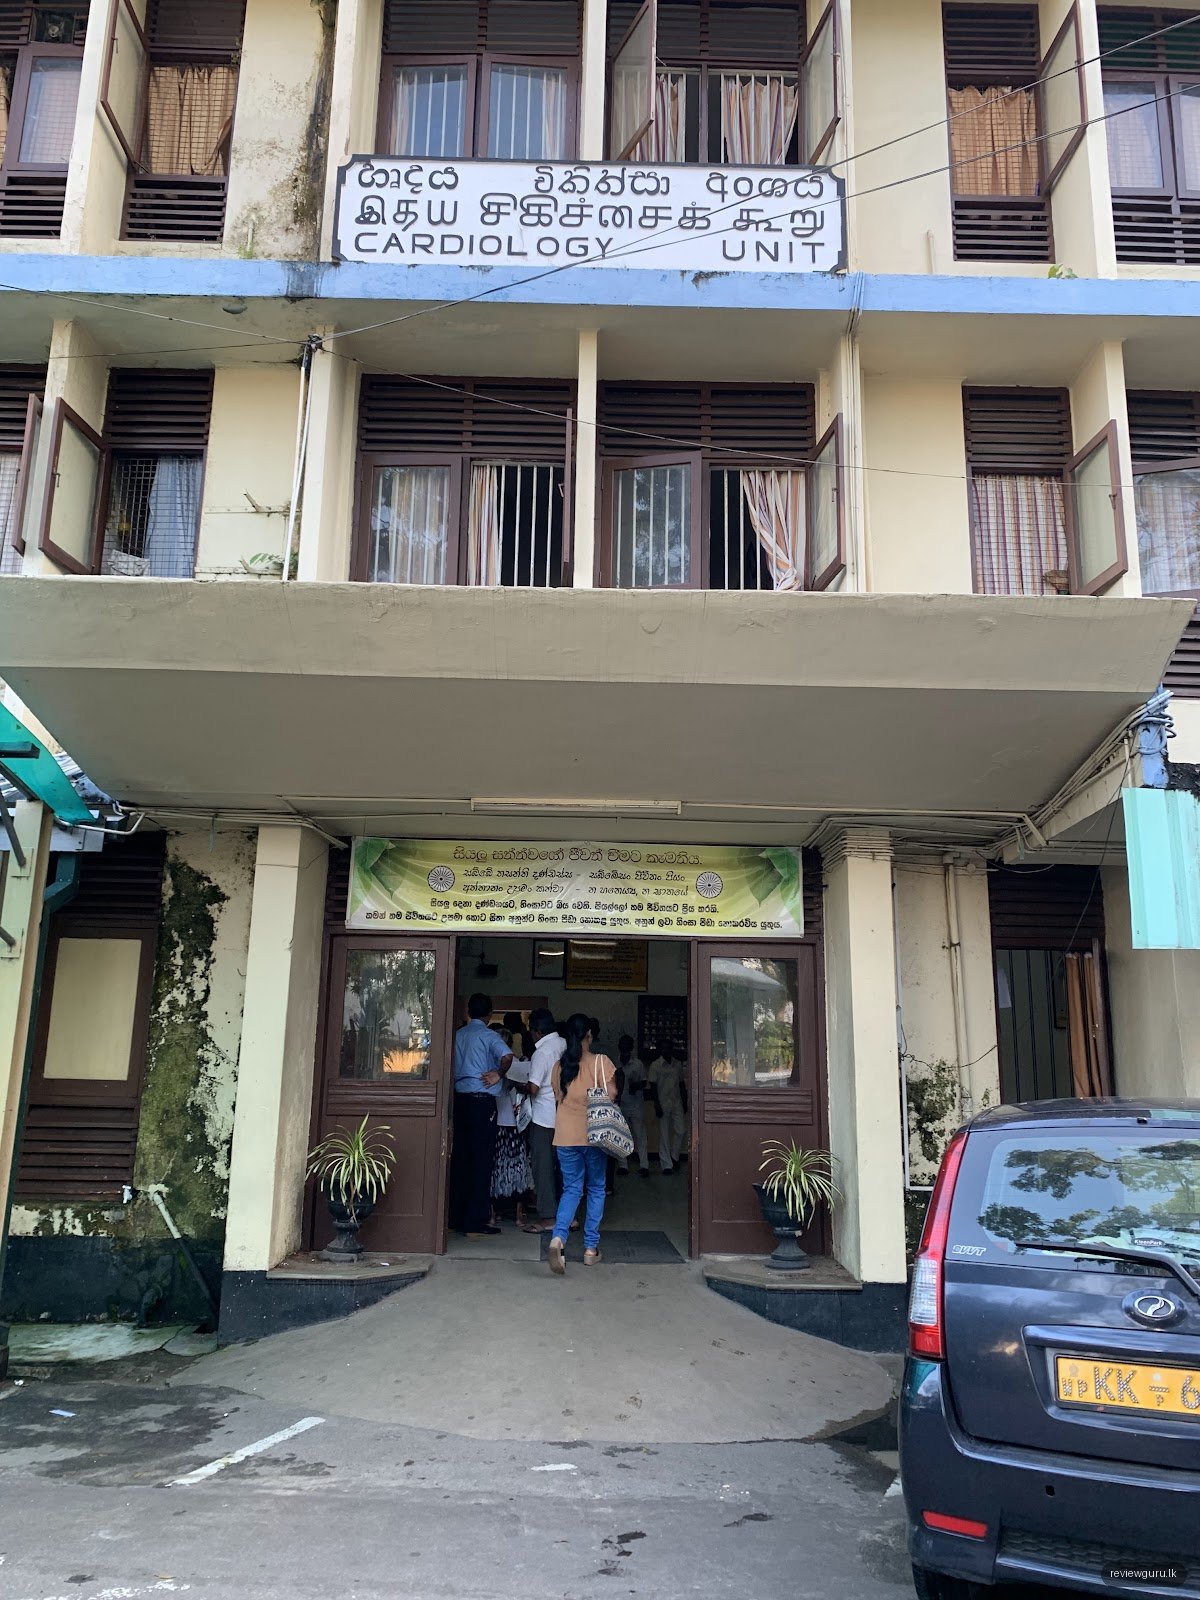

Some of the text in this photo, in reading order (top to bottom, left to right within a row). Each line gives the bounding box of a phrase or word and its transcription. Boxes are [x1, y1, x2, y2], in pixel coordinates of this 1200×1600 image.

[358, 162, 824, 203] හෘදය චිකිත්සා අංශය
[354, 192, 826, 239] இதய சிகிச்சைக் கூறு
[354, 232, 826, 264] CARDIOLOGY UNIT
[454, 846, 487, 862] සියලු
[431, 898, 450, 909] සියලු
[1061, 1377, 1088, 1398] WP
